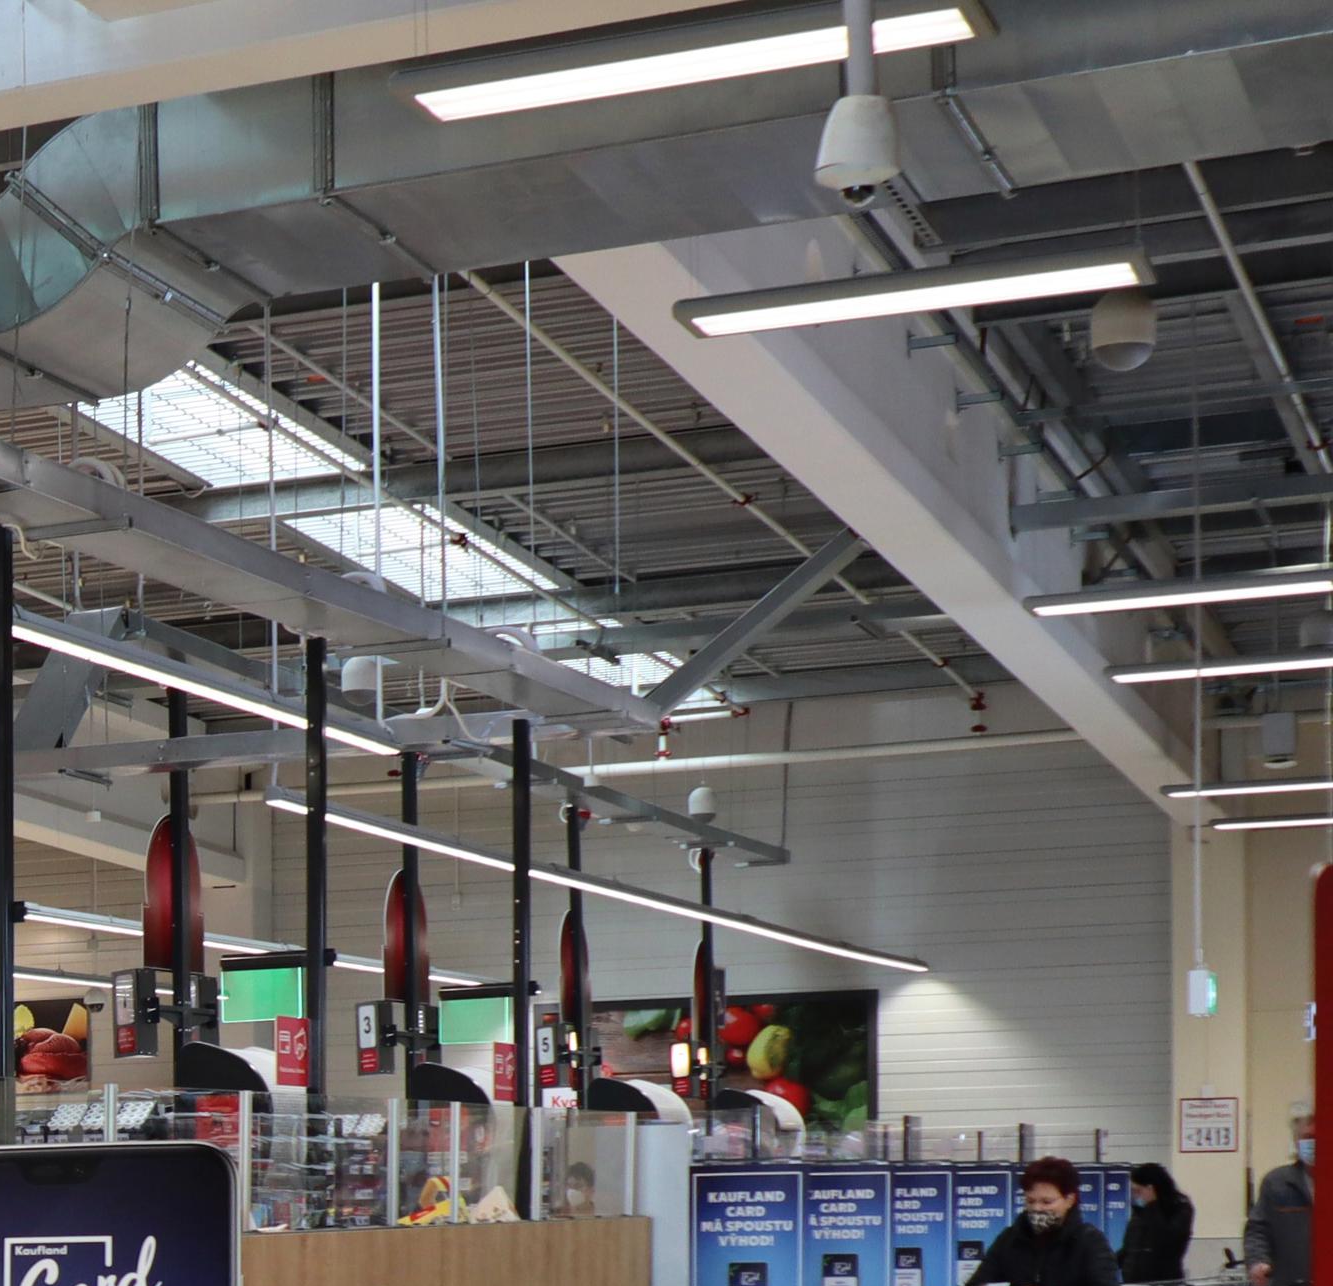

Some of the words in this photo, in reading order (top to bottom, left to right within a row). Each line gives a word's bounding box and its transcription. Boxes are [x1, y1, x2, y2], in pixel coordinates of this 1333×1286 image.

[363, 1016, 372, 1034] 3
[707, 1190, 787, 1204] KAUFLAND
[894, 1186, 939, 1199] FLAND
[819, 1202, 858, 1214] CARD
[894, 1199, 921, 1211] ARD
[958, 1197, 984, 1207] ARD
[725, 1205, 767, 1218] CARD
[700, 1219, 724, 1233] MÁ
[725, 1220, 794, 1233] SPOUSTU
[818, 1215, 883, 1227] SPOUSTU
[717, 1232, 775, 1248] VÝHOD!
[812, 1227, 866, 1241] VÝHOD!
[13, 1245, 69, 1257] Kaufland
